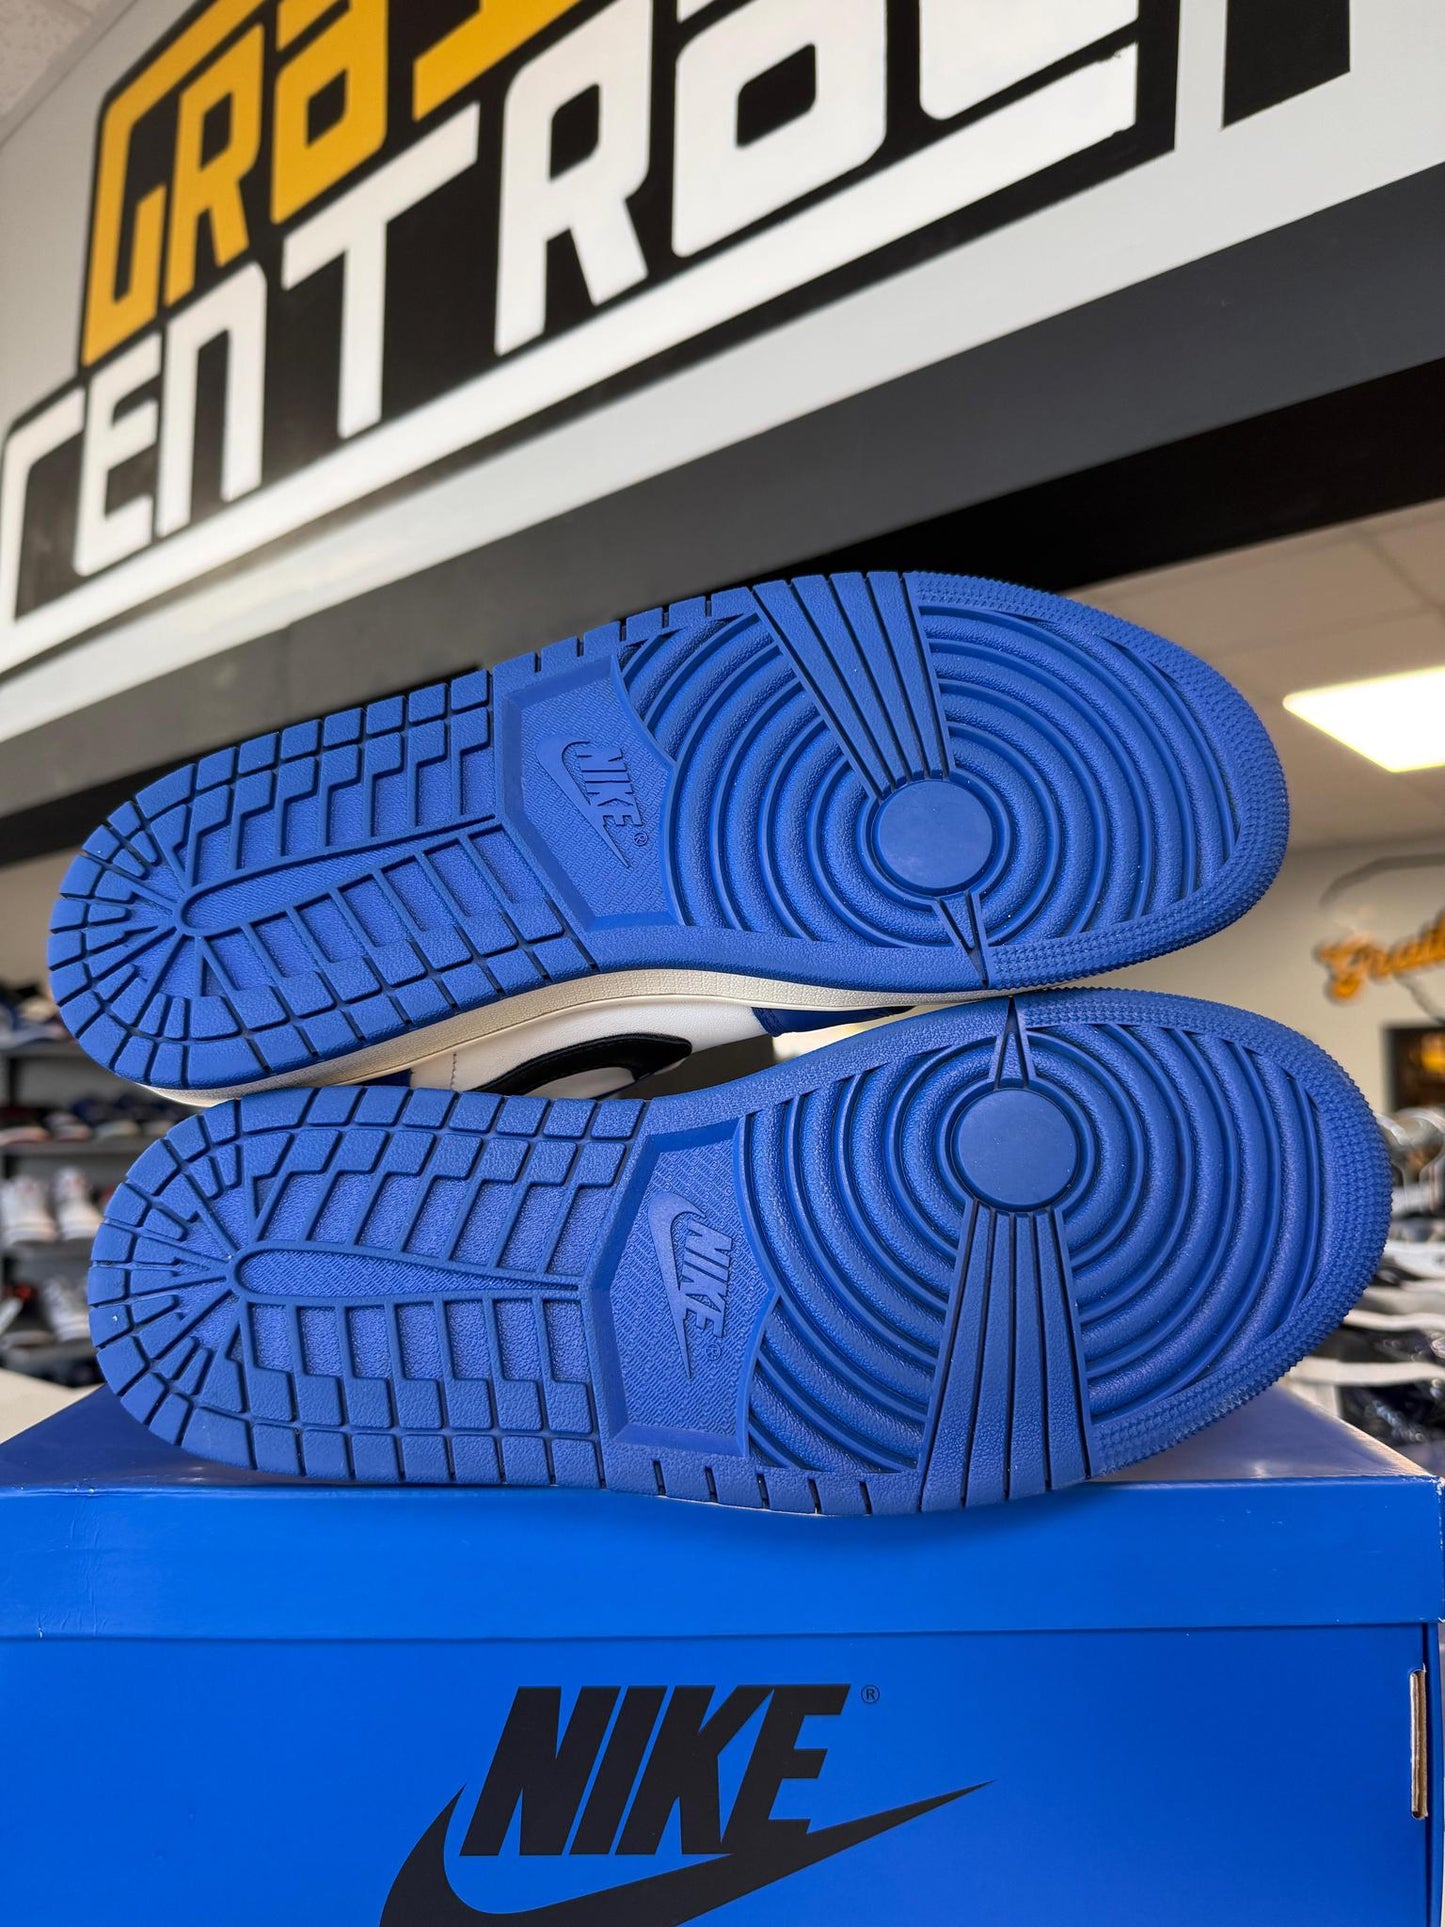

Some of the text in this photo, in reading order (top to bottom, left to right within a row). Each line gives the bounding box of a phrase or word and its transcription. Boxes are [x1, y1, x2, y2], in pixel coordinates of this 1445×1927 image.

[575, 743, 644, 827] NIKE
[678, 1218, 733, 1338] NIKE
[459, 1684, 851, 1856] NIKE
